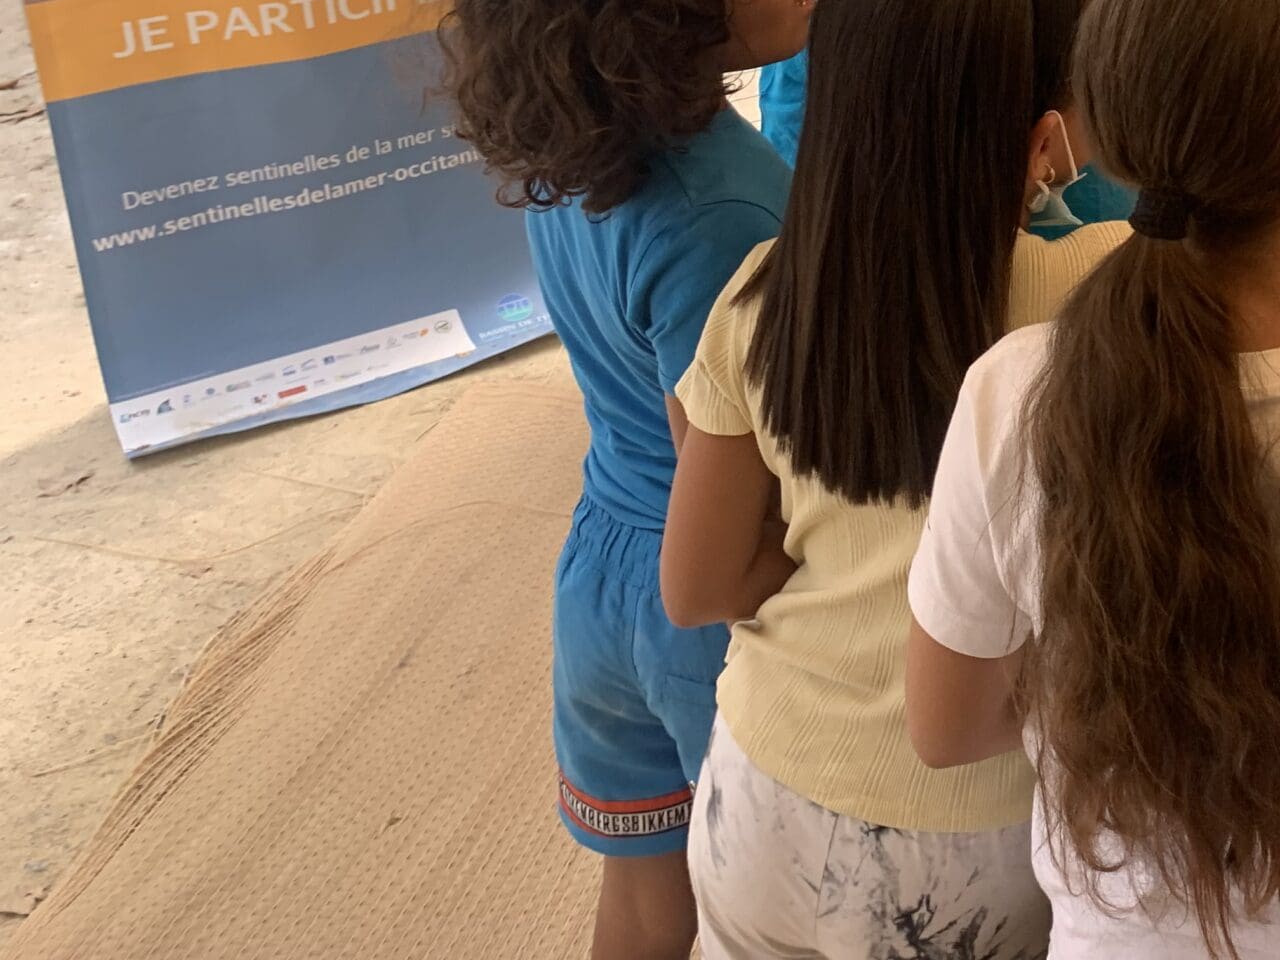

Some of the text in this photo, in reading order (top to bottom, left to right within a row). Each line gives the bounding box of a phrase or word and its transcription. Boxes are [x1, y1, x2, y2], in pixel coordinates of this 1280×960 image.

[112, 14, 173, 59] JE
[121, 124, 456, 211] Devenez sentinelles de la mer s
